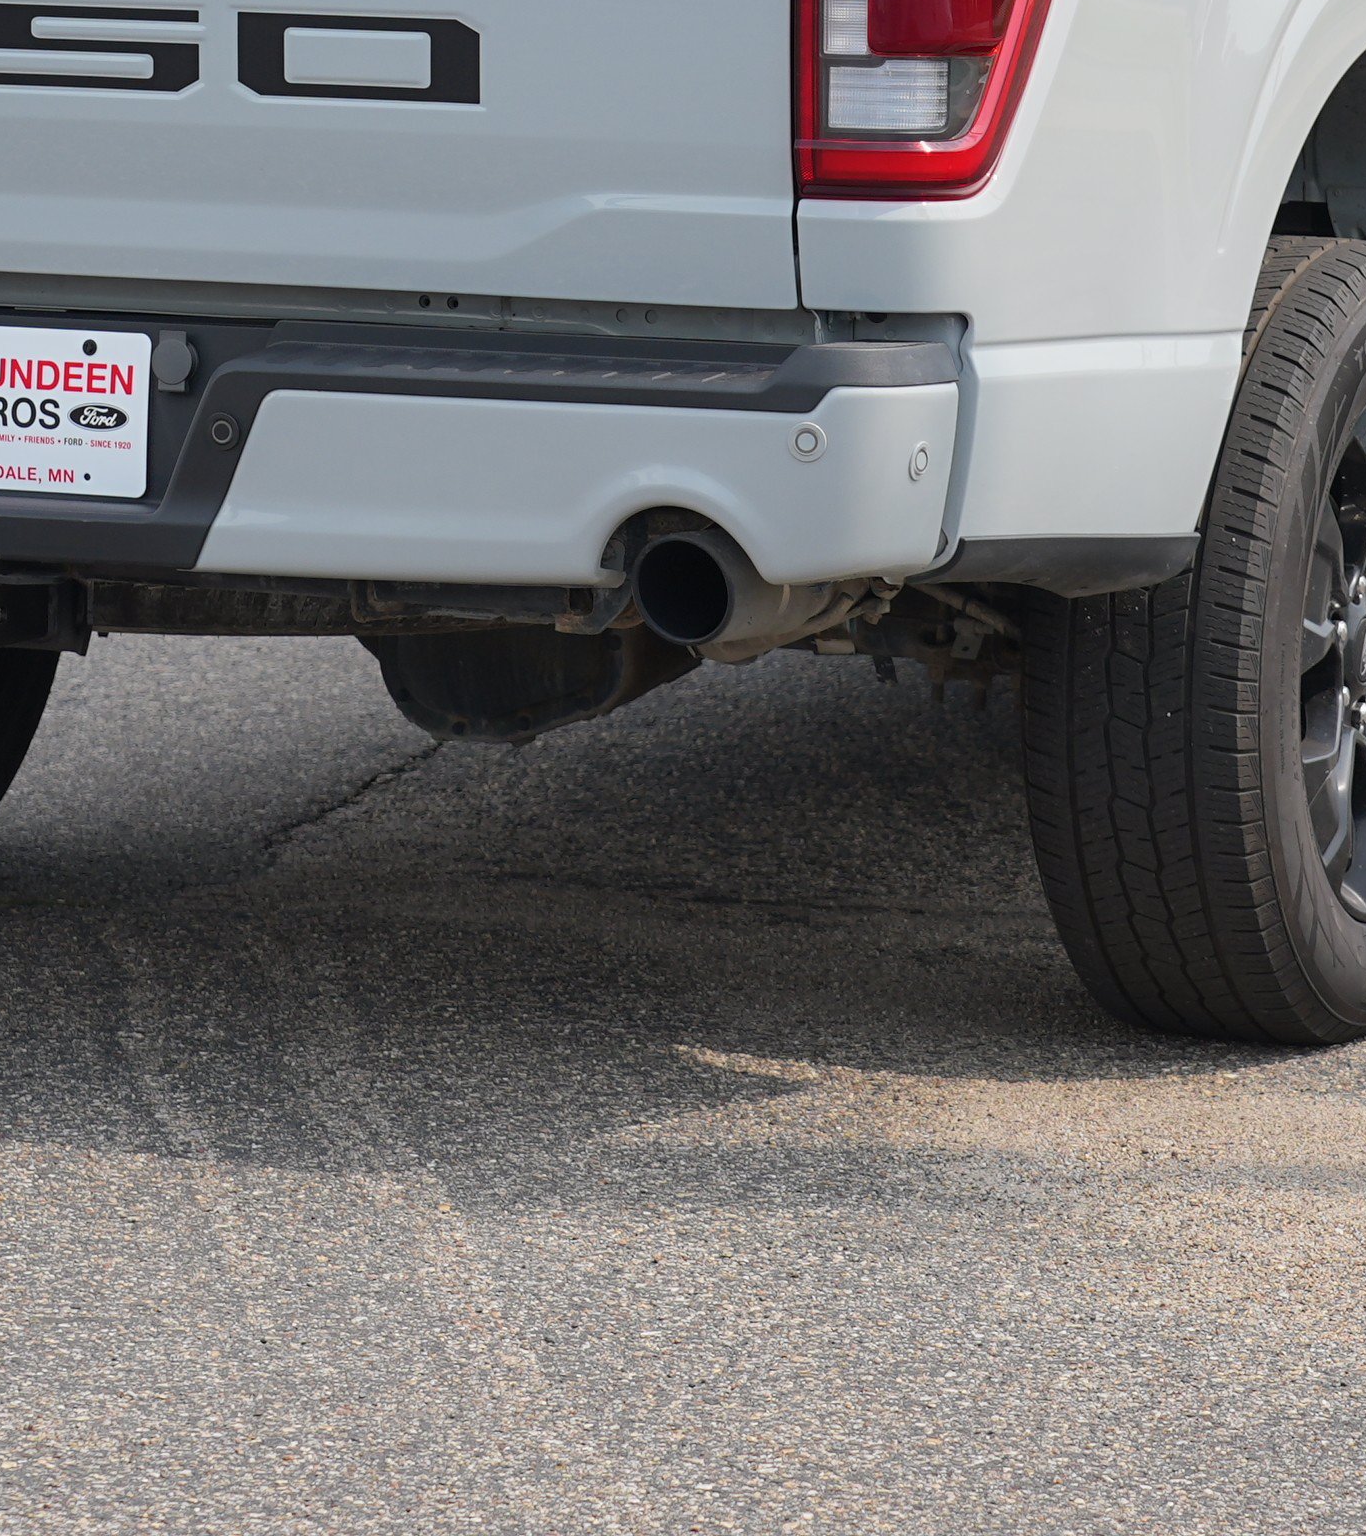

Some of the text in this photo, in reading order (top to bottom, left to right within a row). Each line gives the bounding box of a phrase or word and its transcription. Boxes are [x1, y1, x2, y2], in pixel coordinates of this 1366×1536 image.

[24, 435, 55, 445] FRIENDS
[63, 437, 83, 446] FORD
[90, 439, 112, 448] SINCE
[114, 441, 132, 450] 1920
[48, 467, 75, 483] MN
